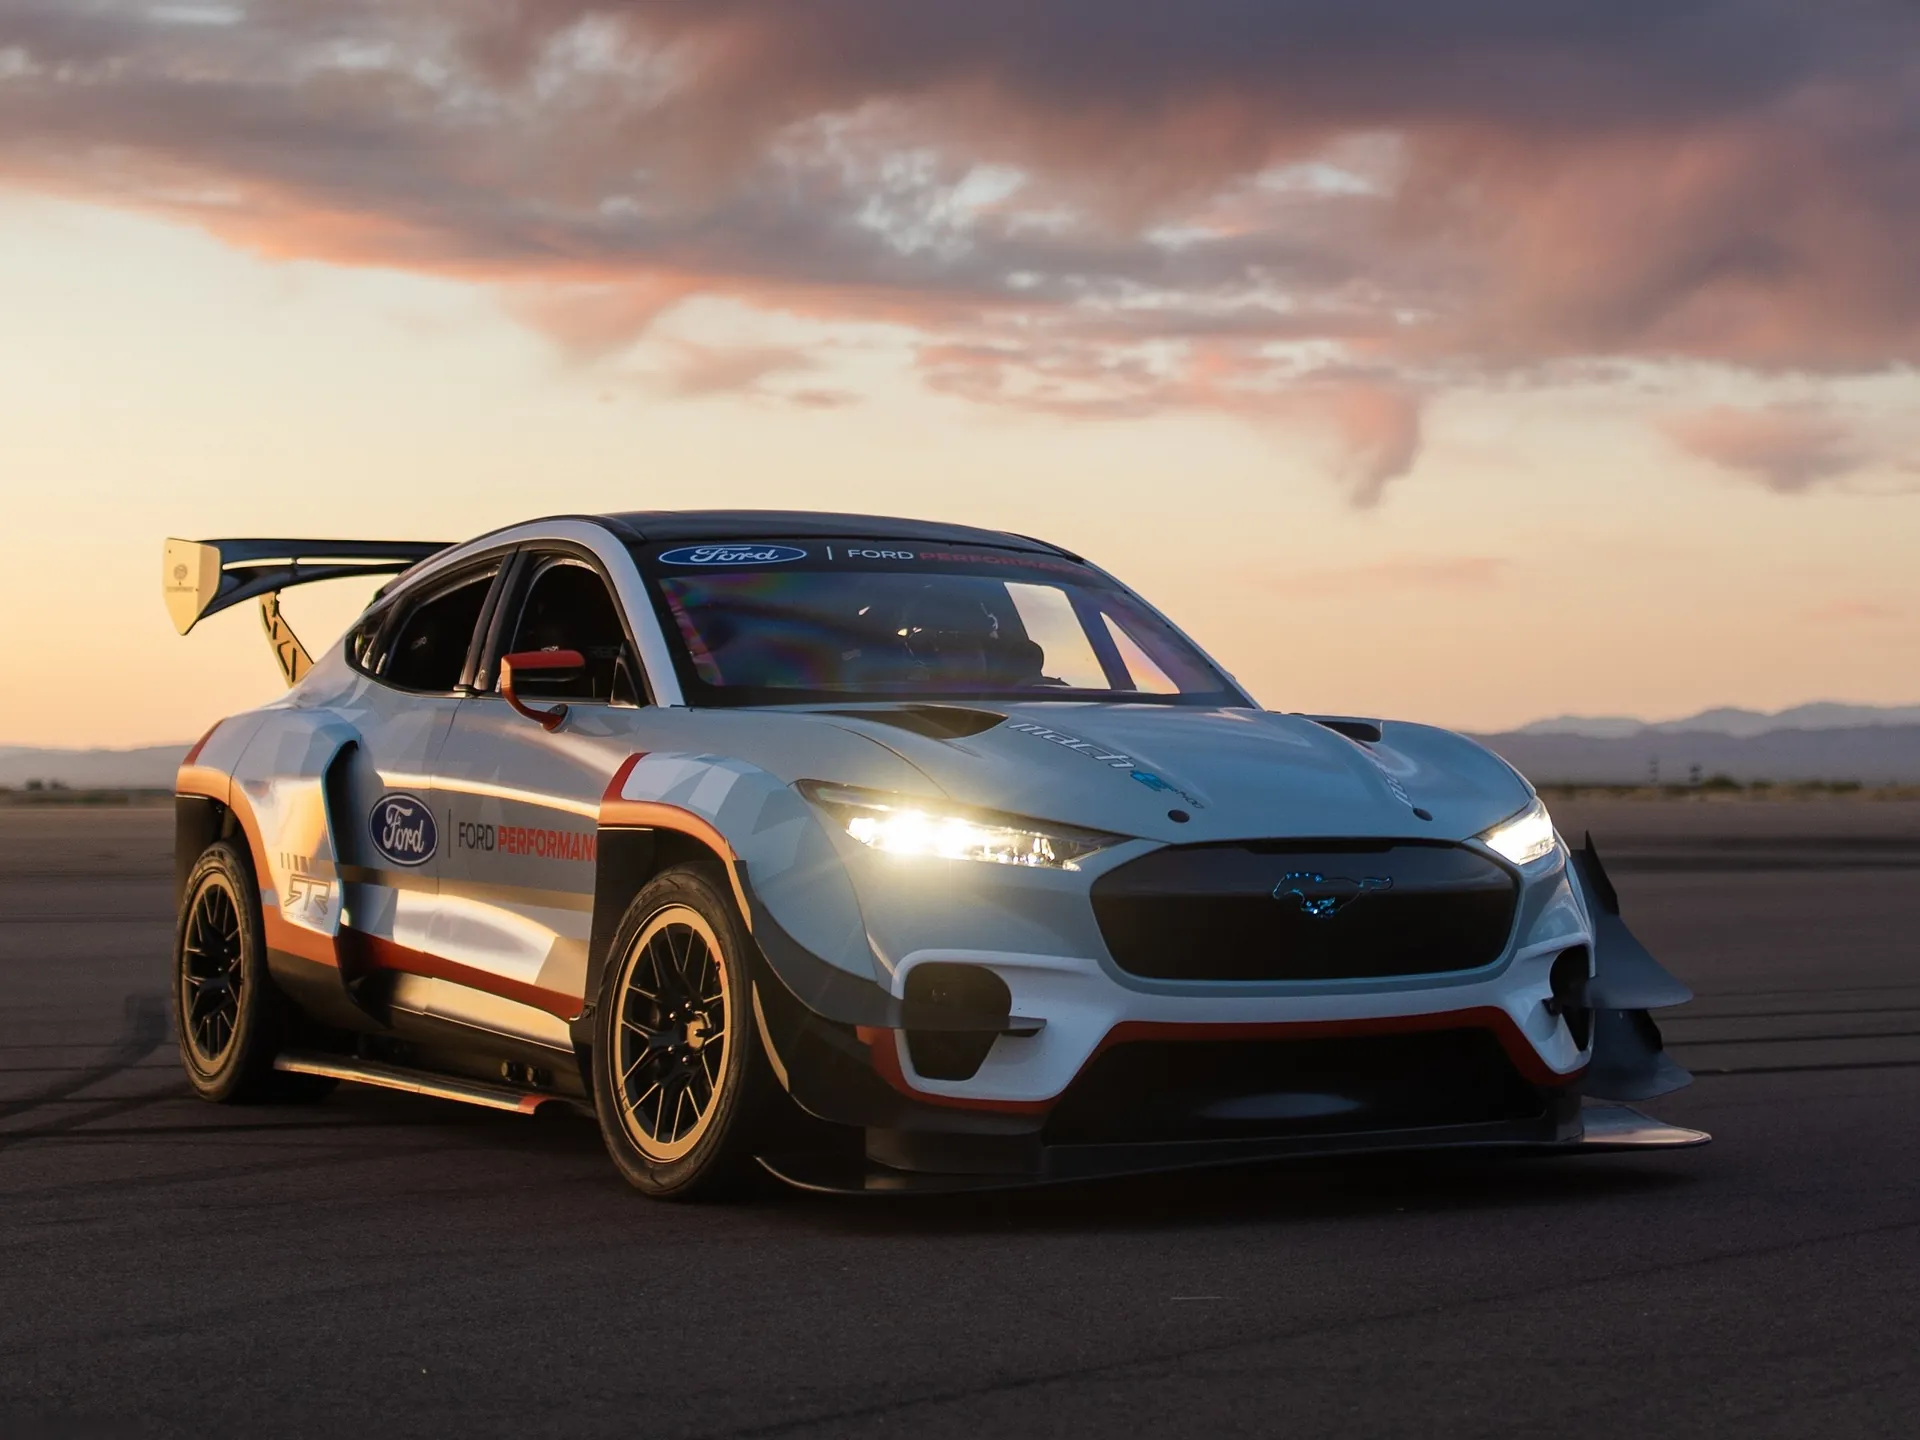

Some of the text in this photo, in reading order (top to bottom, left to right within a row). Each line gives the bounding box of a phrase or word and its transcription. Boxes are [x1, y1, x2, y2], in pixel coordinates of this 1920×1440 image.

[690, 547, 779, 563] Ford
[848, 548, 914, 560] FORD
[1007, 723, 1136, 769] mach
[383, 803, 425, 853] Ford
[459, 821, 597, 862] FORD PERFORMAN
